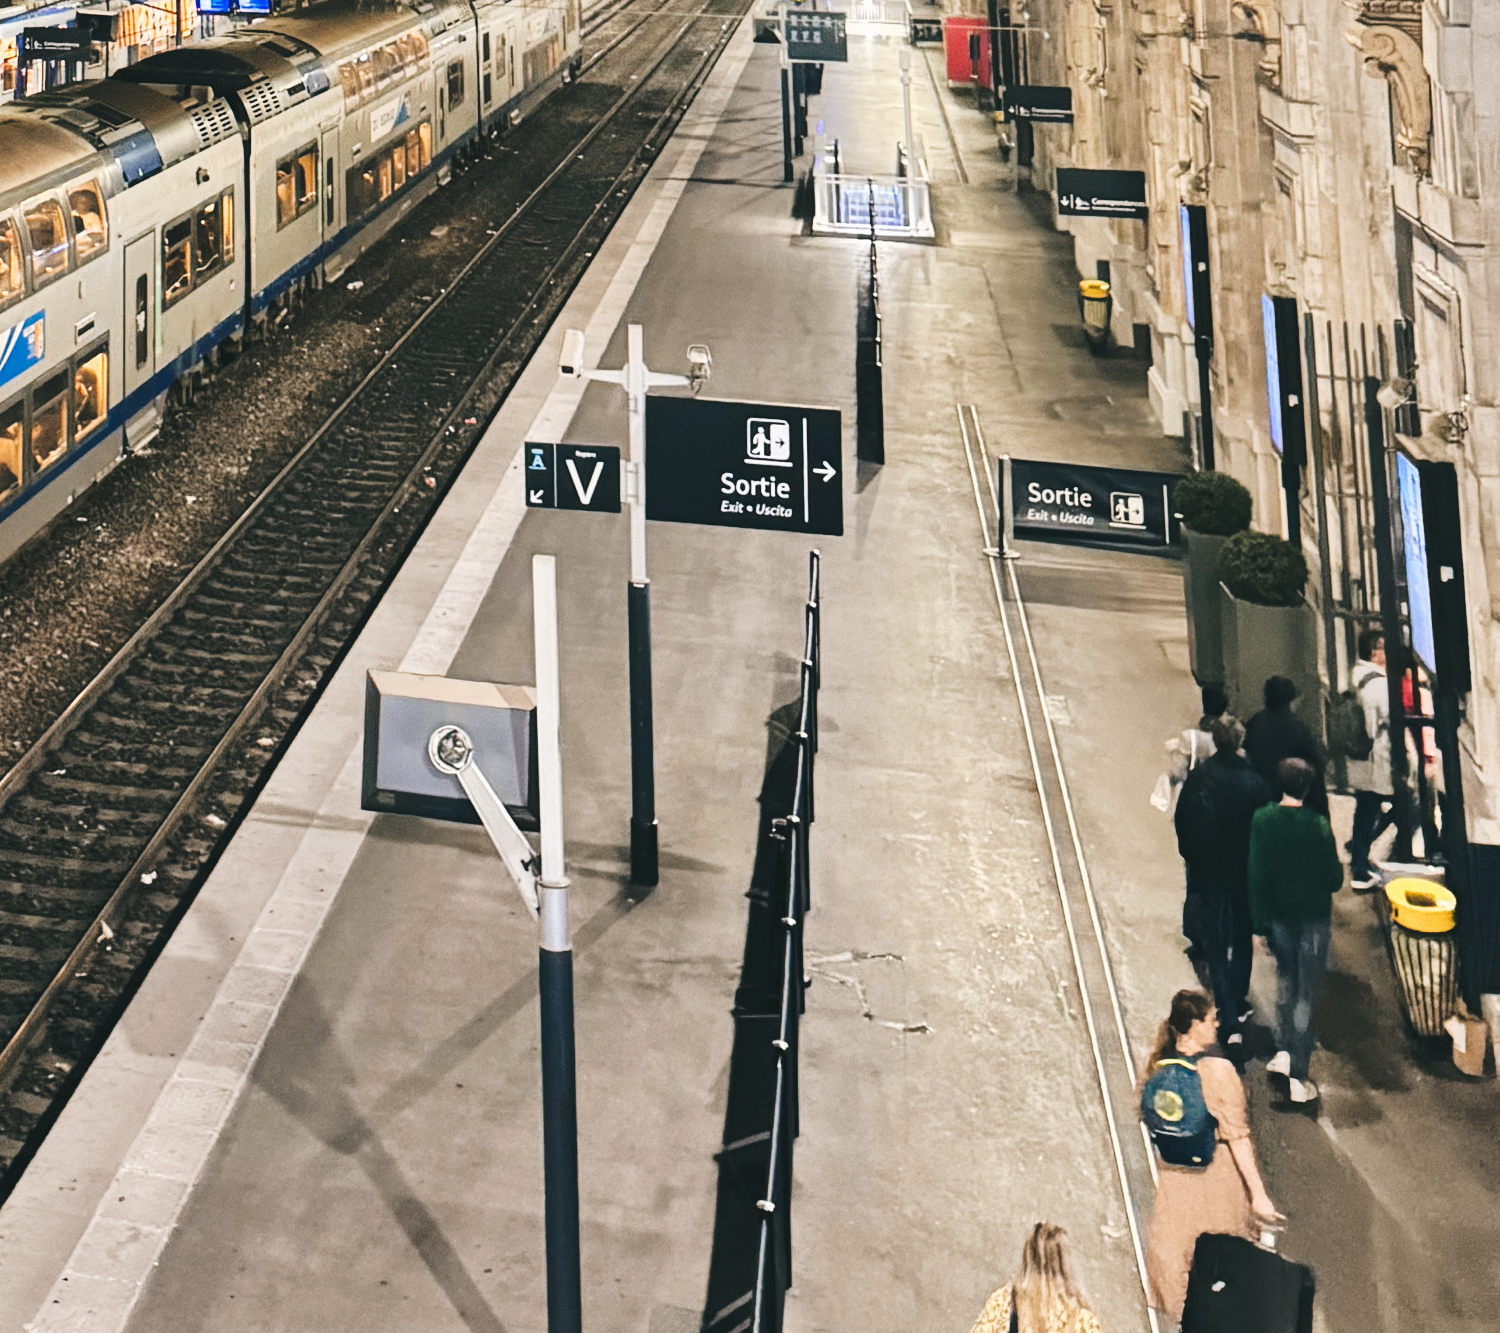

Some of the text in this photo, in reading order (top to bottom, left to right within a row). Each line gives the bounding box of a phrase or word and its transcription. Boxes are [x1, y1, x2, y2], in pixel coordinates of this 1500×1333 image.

[531, 453, 545, 469] A
[564, 458, 604, 505] V
[720, 472, 791, 499] Sortie
[1027, 481, 1092, 508] Sortie
[720, 499, 793, 518] Exit Uscita
[1026, 508, 1095, 526] Exit Uscita
